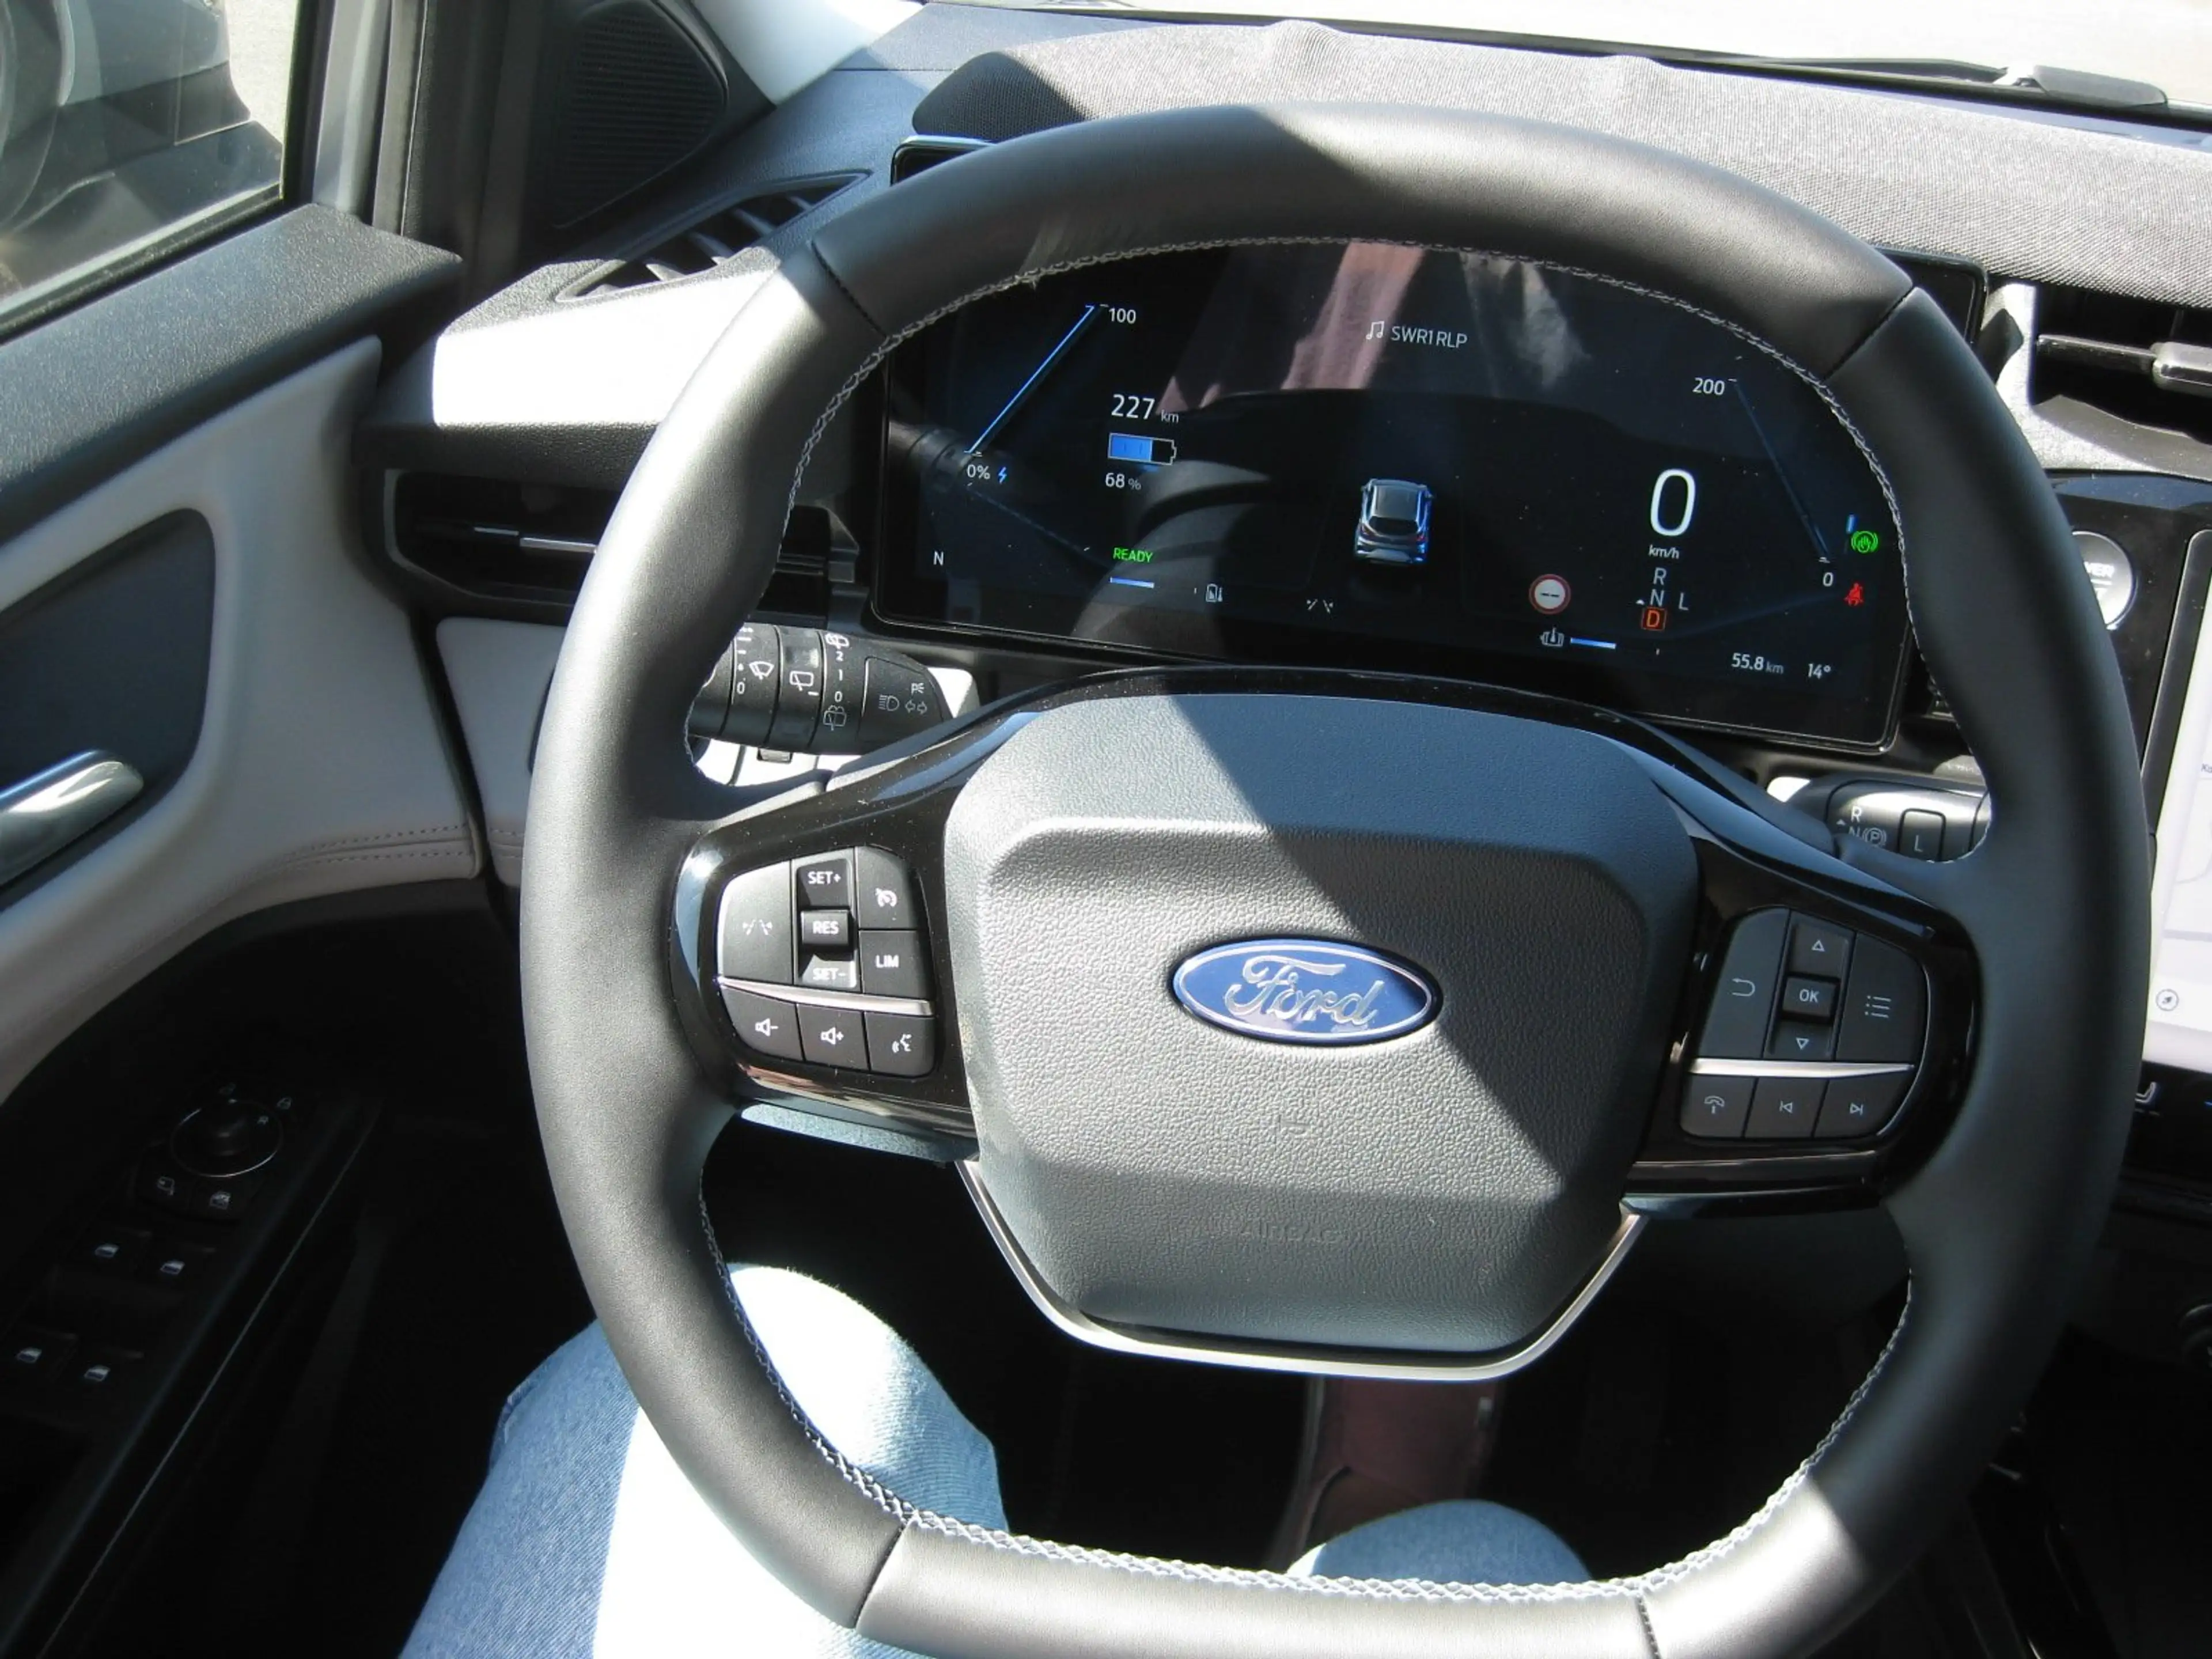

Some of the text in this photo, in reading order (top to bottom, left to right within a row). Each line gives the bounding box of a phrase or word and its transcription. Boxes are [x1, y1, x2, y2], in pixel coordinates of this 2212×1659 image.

[1109, 308, 1136, 324] 100
[1692, 377, 1725, 396] 200
[1111, 393, 1179, 424] 227 km
[967, 464, 991, 480] 0%
[1105, 472, 1125, 488] 68
[1649, 468, 1696, 536] 0
[933, 550, 944, 566] N
[1112, 547, 1153, 563] READY
[1648, 543, 1680, 559] km/h
[1653, 566, 1667, 586] R
[1822, 572, 1834, 587] 0
[1650, 588, 1665, 607] N
[1678, 592, 1690, 611] L
[1646, 609, 1661, 628] D
[835, 651, 844, 662] 2
[1731, 652, 1785, 675] 55.8 km
[736, 684, 745, 695] 0
[834, 691, 843, 702] 0
[1850, 805, 1862, 823] R
[1913, 834, 1924, 853] L
[808, 870, 842, 885] SET+
[812, 920, 839, 935] RES
[874, 954, 900, 969] LIM
[1224, 954, 1385, 1026] Ford
[1798, 988, 1819, 1003] OK
